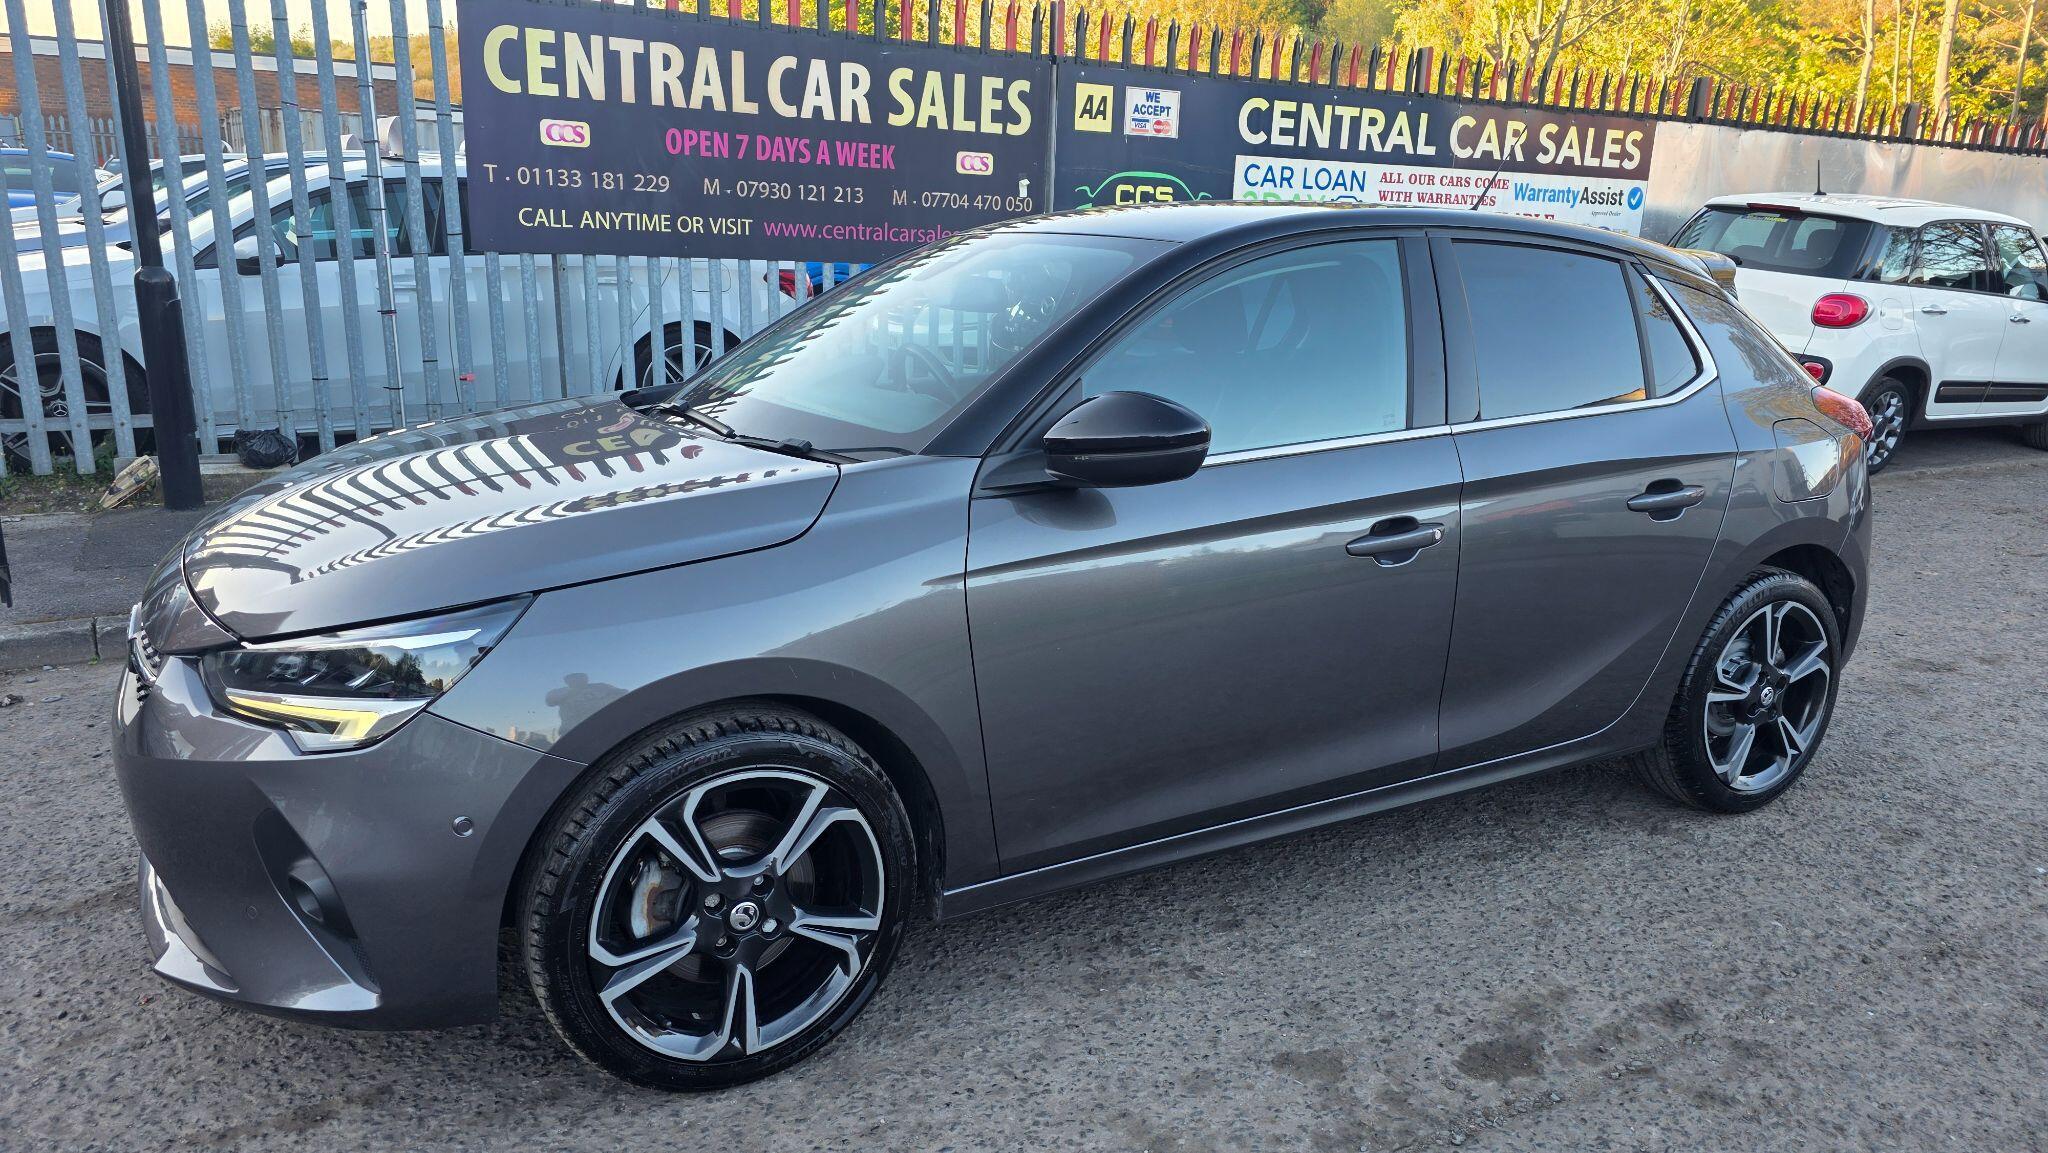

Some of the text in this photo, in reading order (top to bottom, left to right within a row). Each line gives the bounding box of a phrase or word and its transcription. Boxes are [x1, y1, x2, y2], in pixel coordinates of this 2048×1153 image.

[483, 24, 1032, 136] CENTRAL CAR SALES
[1079, 94, 1108, 121] AA
[1145, 91, 1161, 103] WE
[1132, 103, 1171, 117] ACCEPT
[545, 123, 586, 144] CCS
[1238, 97, 1644, 170] CENTRAL CAR SALES
[665, 127, 896, 170] OPEN 7 DAYS A WEEK
[960, 154, 990, 172] CCS
[517, 166, 582, 188] 01133
[591, 171, 624, 190] 181
[633, 173, 670, 193] 229
[1243, 163, 1367, 193] CAR LOAN
[1379, 171, 1510, 190] ALL OUR CARS COME
[736, 180, 792, 200] 07930
[798, 184, 825, 202] 121
[833, 186, 864, 204] 213
[921, 191, 970, 209] 07704
[973, 194, 1001, 211] 470
[1005, 196, 1033, 212] 050
[1378, 190, 1413, 203] WITH
[518, 207, 574, 228] CALL
[580, 210, 672, 233] ANYTIME
[677, 215, 704, 234] OR
[709, 217, 753, 236] VISIT
